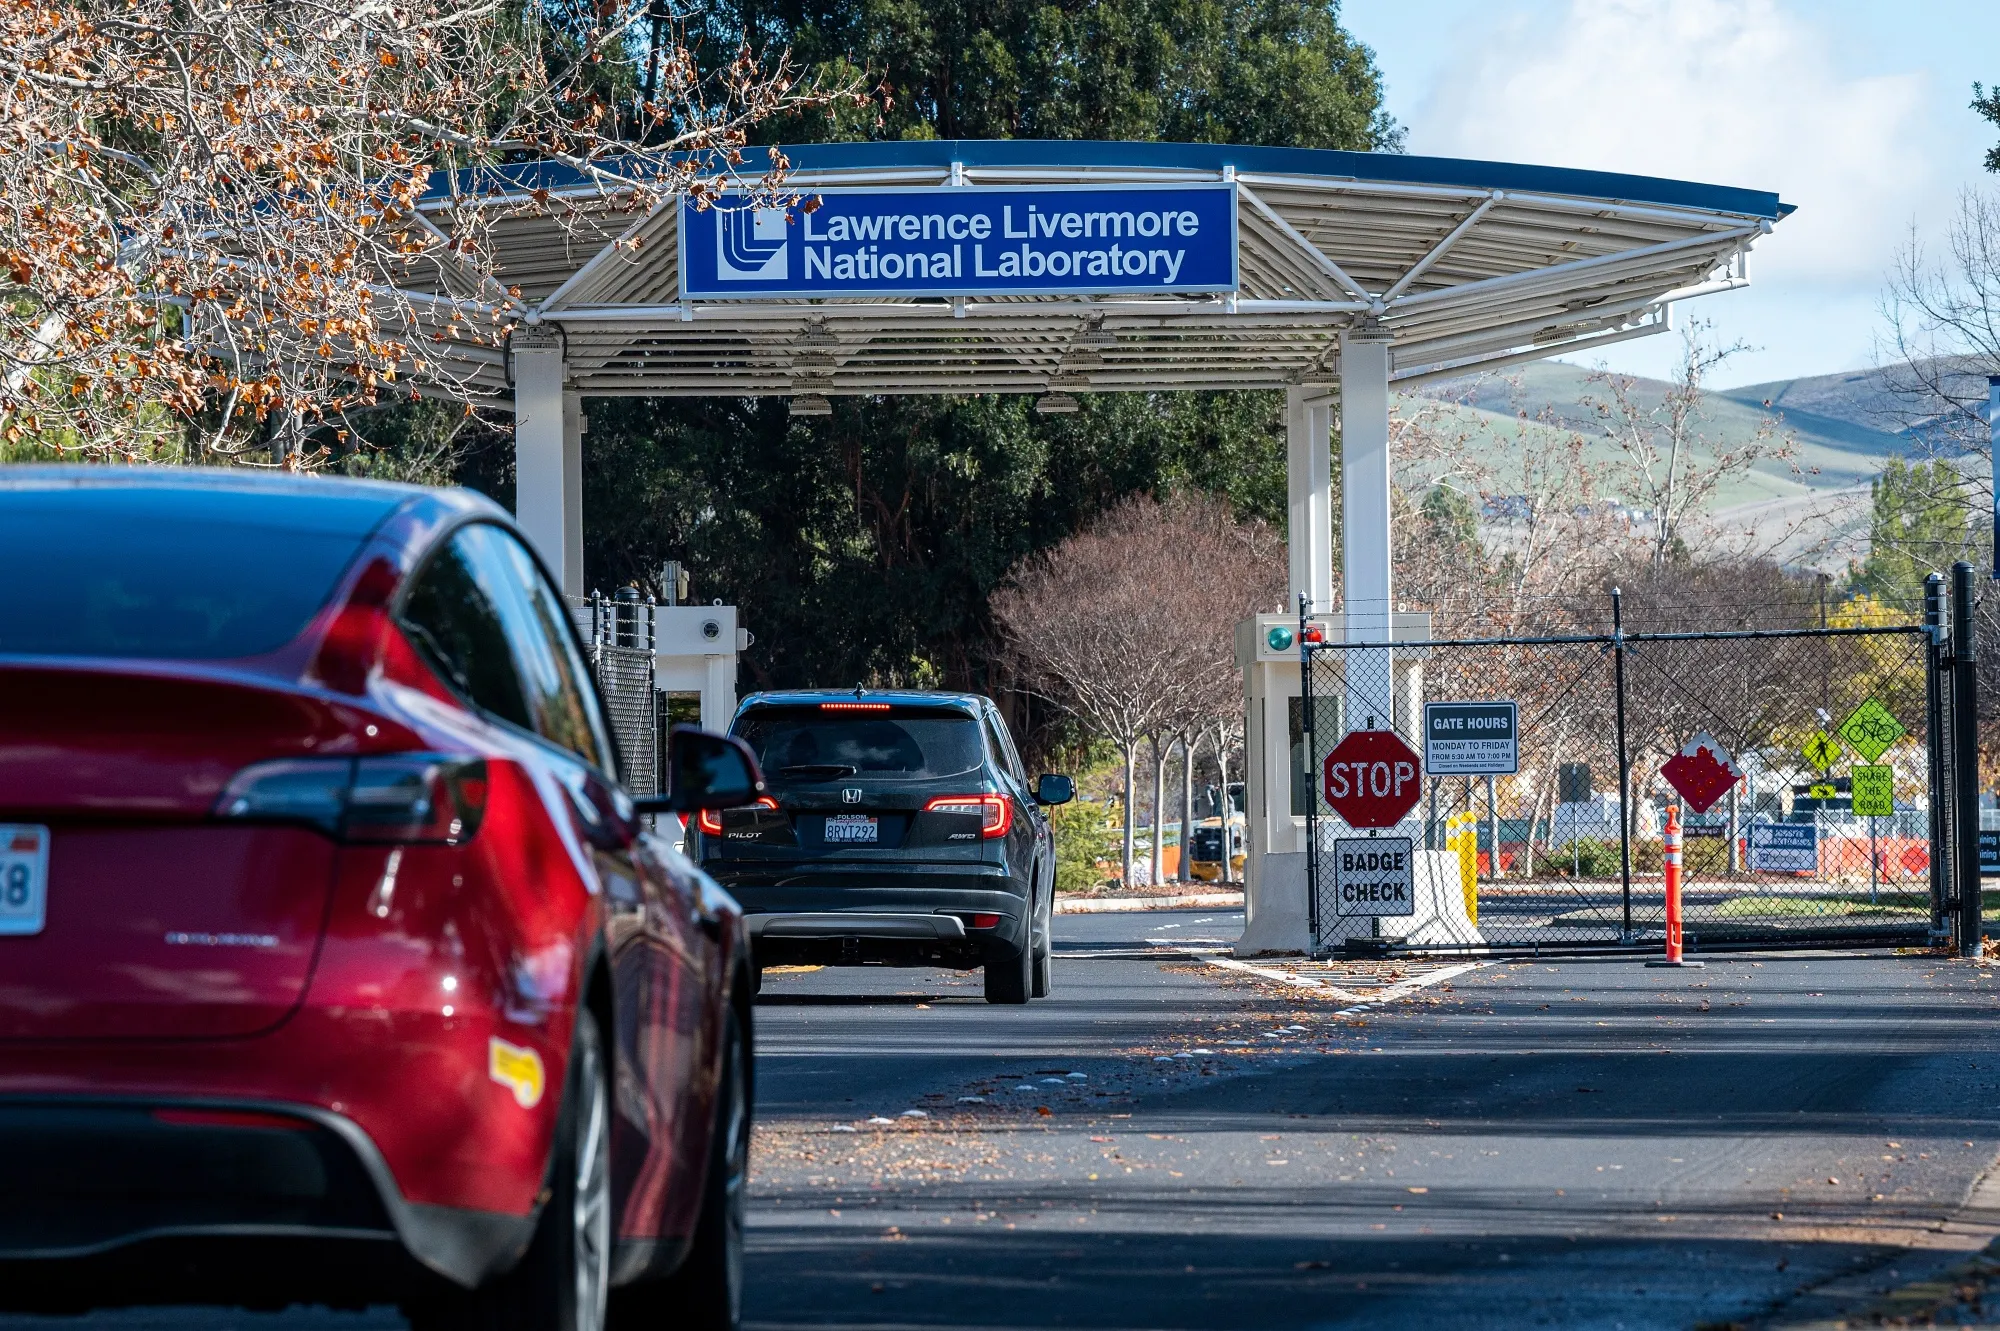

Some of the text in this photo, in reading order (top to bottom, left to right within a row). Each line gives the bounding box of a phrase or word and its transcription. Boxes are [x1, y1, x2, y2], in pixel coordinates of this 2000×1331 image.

[803, 204, 1199, 242] Lawrence Livermore
[804, 242, 1186, 284] National Laboratory
[1433, 716, 1508, 730] GATE HOURS
[1432, 741, 1510, 750] MONDAY TO FRIDAY
[1330, 761, 1415, 798] STOP
[1857, 772, 1888, 781] SHARE
[1864, 786, 1881, 795] THE
[1859, 800, 1885, 810] ROAD
[827, 825, 875, 839] 8RYT292
[1343, 852, 1404, 872] BADGE
[0, 863, 31, 907] 8
[1342, 882, 1406, 902] CHECK
